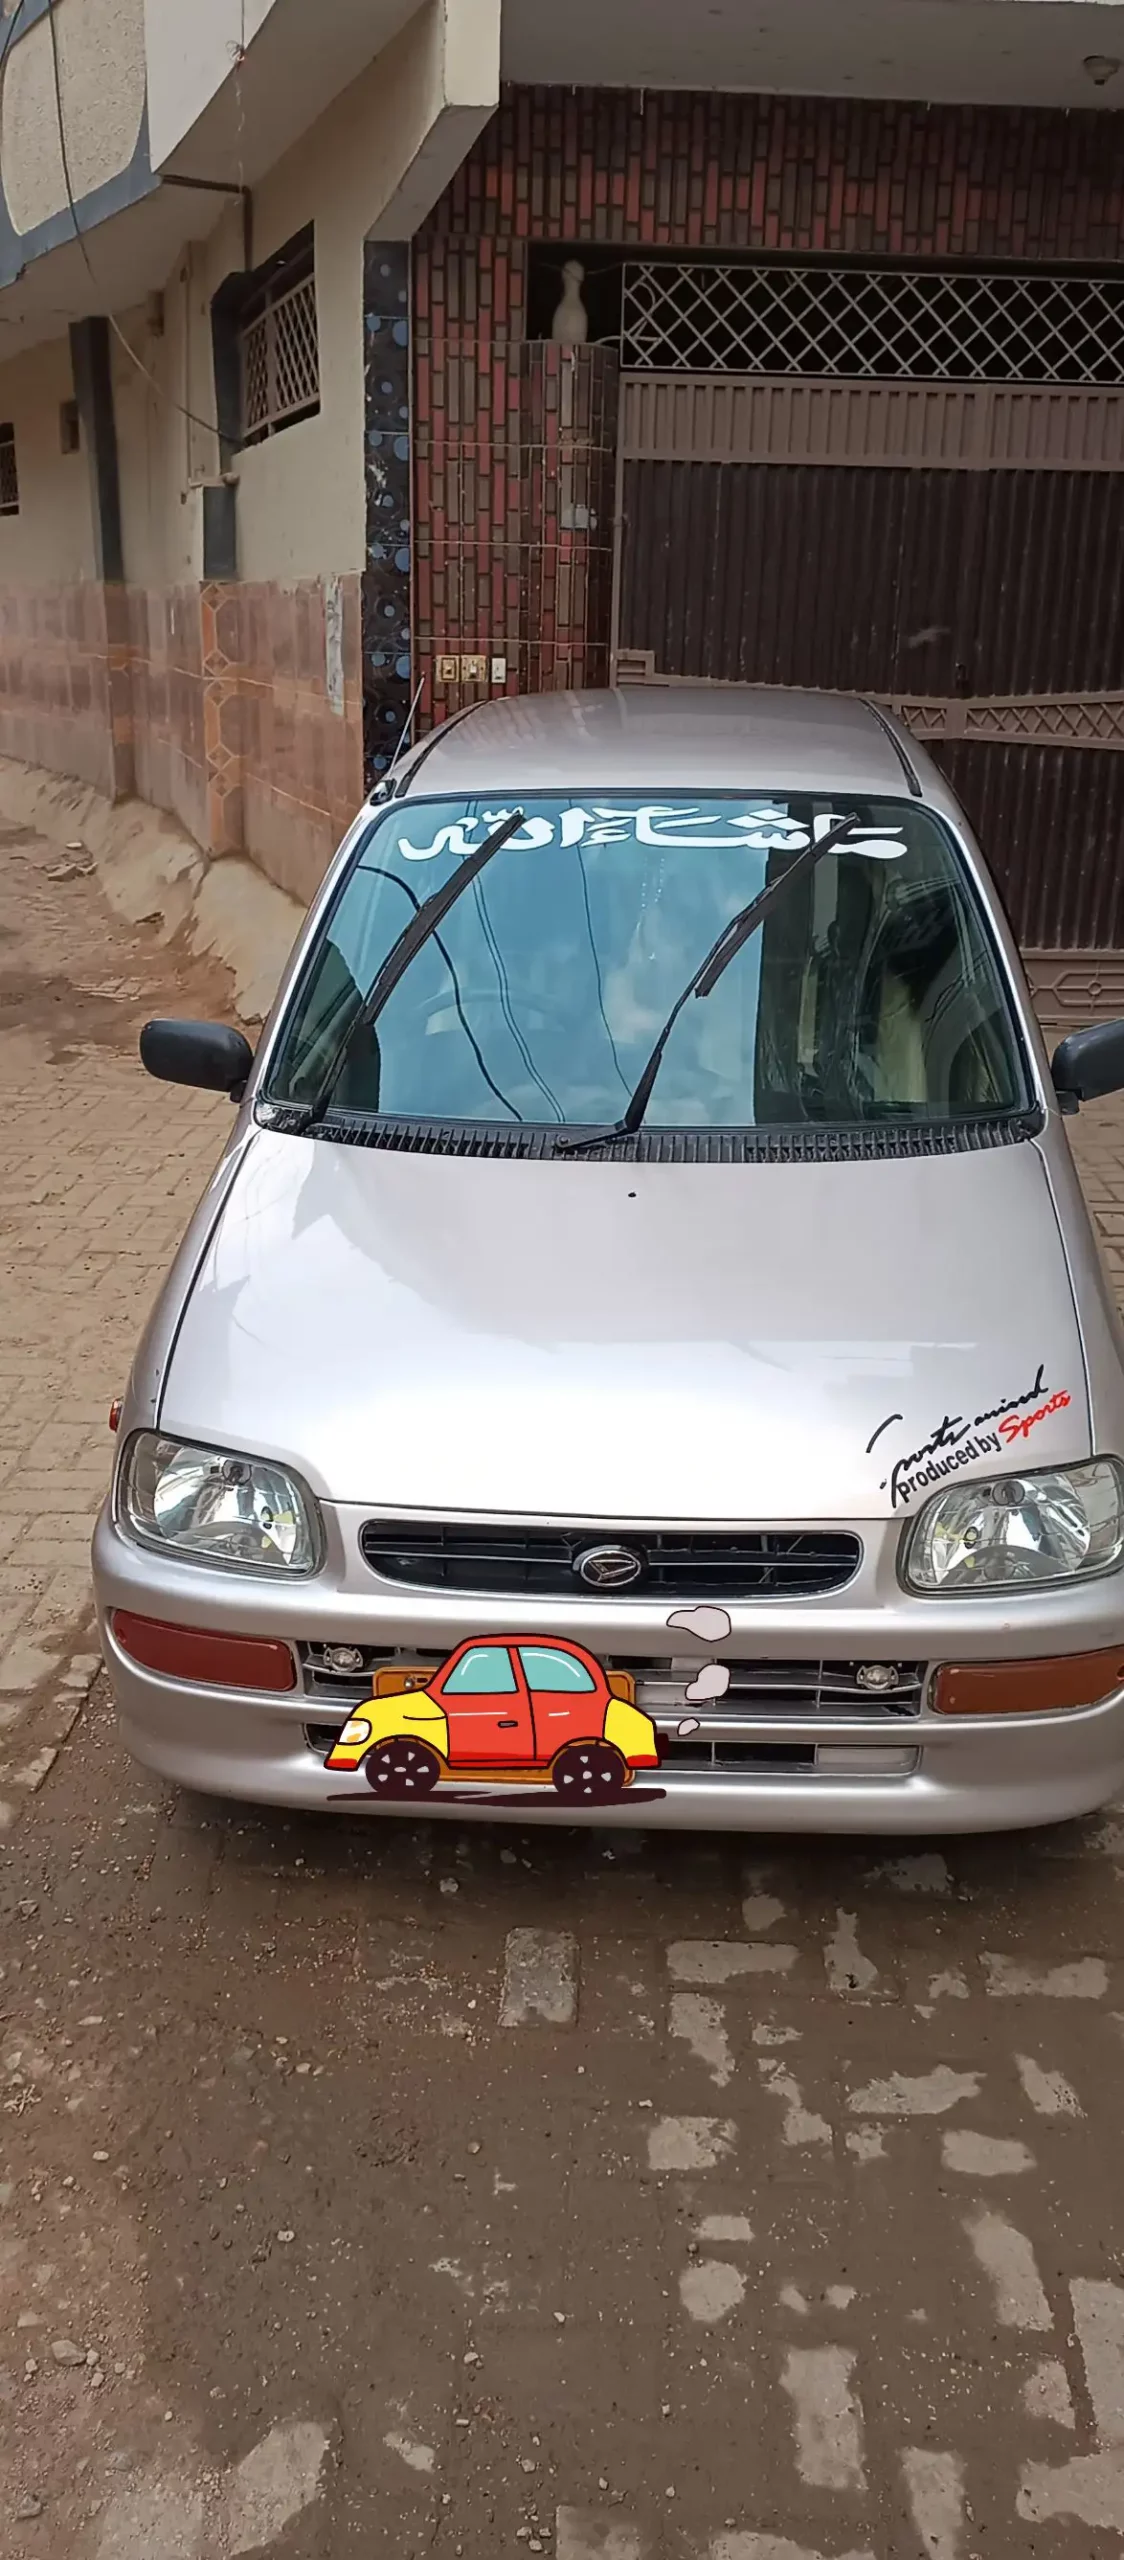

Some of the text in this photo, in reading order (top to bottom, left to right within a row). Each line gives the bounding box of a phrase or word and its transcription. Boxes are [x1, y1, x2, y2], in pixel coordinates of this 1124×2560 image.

[896, 1389, 1072, 1503] produced by Sports
